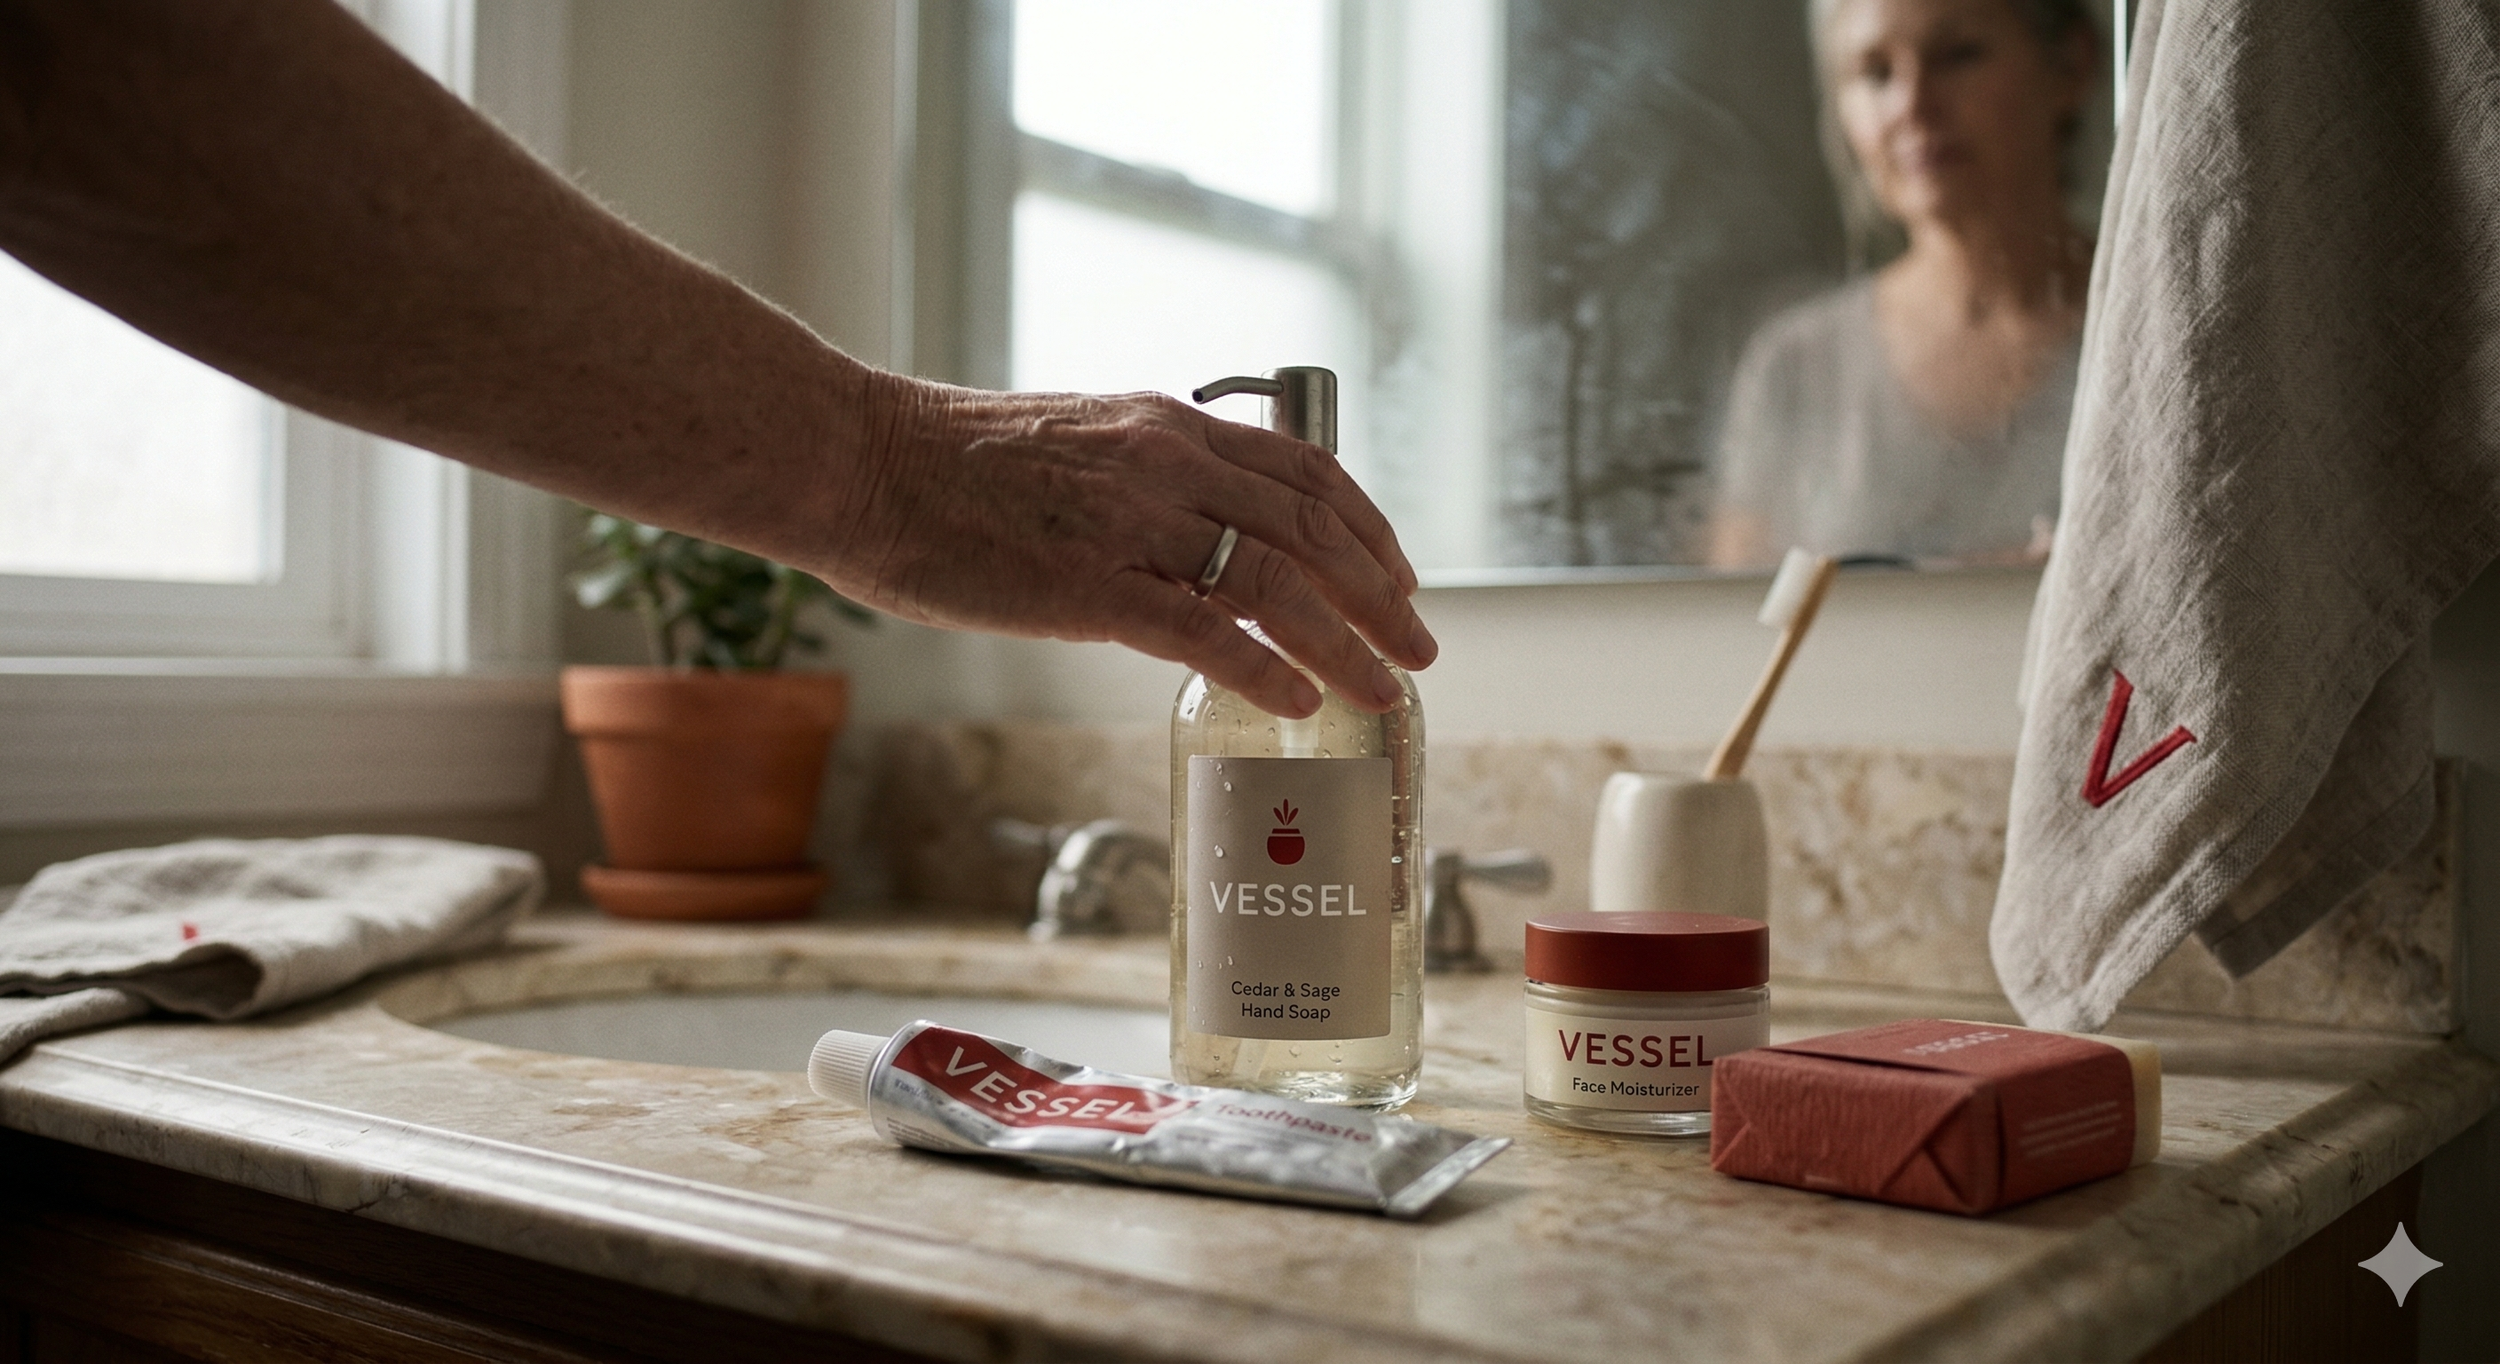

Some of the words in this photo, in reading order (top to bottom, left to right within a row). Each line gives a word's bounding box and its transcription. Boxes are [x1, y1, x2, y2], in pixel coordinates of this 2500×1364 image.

[2082, 667, 2197, 809] V
[1209, 881, 1367, 917] VESSEL
[1231, 980, 1279, 998] Cedar
[1283, 982, 1296, 998] &
[1300, 983, 1341, 1001] Sage
[1241, 1002, 1284, 1019] Hand
[1288, 1004, 1331, 1023] Soap
[1558, 1029, 1714, 1068] VESSEL
[945, 1046, 1150, 1124] VESSEL
[1217, 1103, 1373, 1143] Toothpaste
[1573, 1077, 1607, 1095] Face
[1610, 1081, 1700, 1097] Moisturizer
